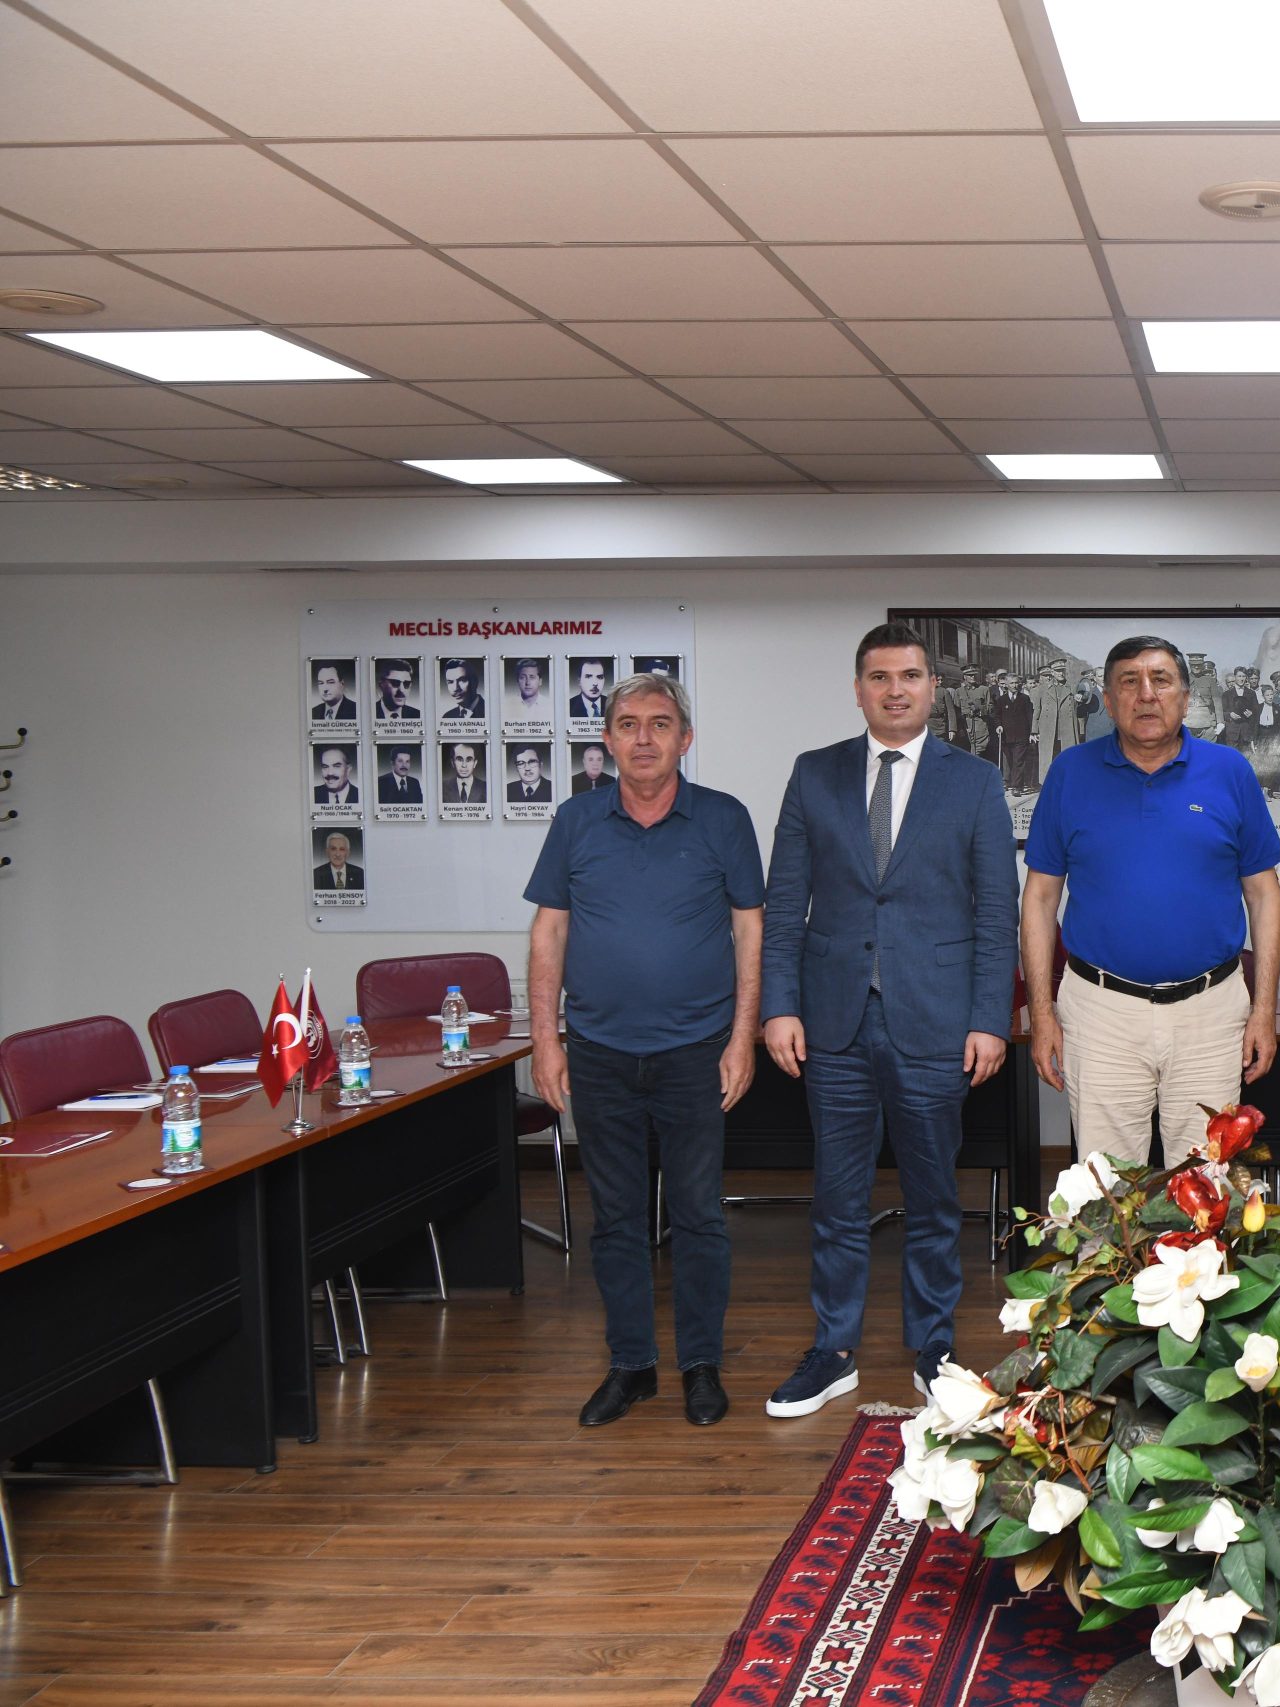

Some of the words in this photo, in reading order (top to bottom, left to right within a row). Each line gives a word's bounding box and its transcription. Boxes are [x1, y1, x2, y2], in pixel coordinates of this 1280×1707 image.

[389, 618, 453, 637] MECLİS
[458, 620, 603, 640] BAŞKANLARIMIZ
[338, 892, 364, 900] ŞENSOY
